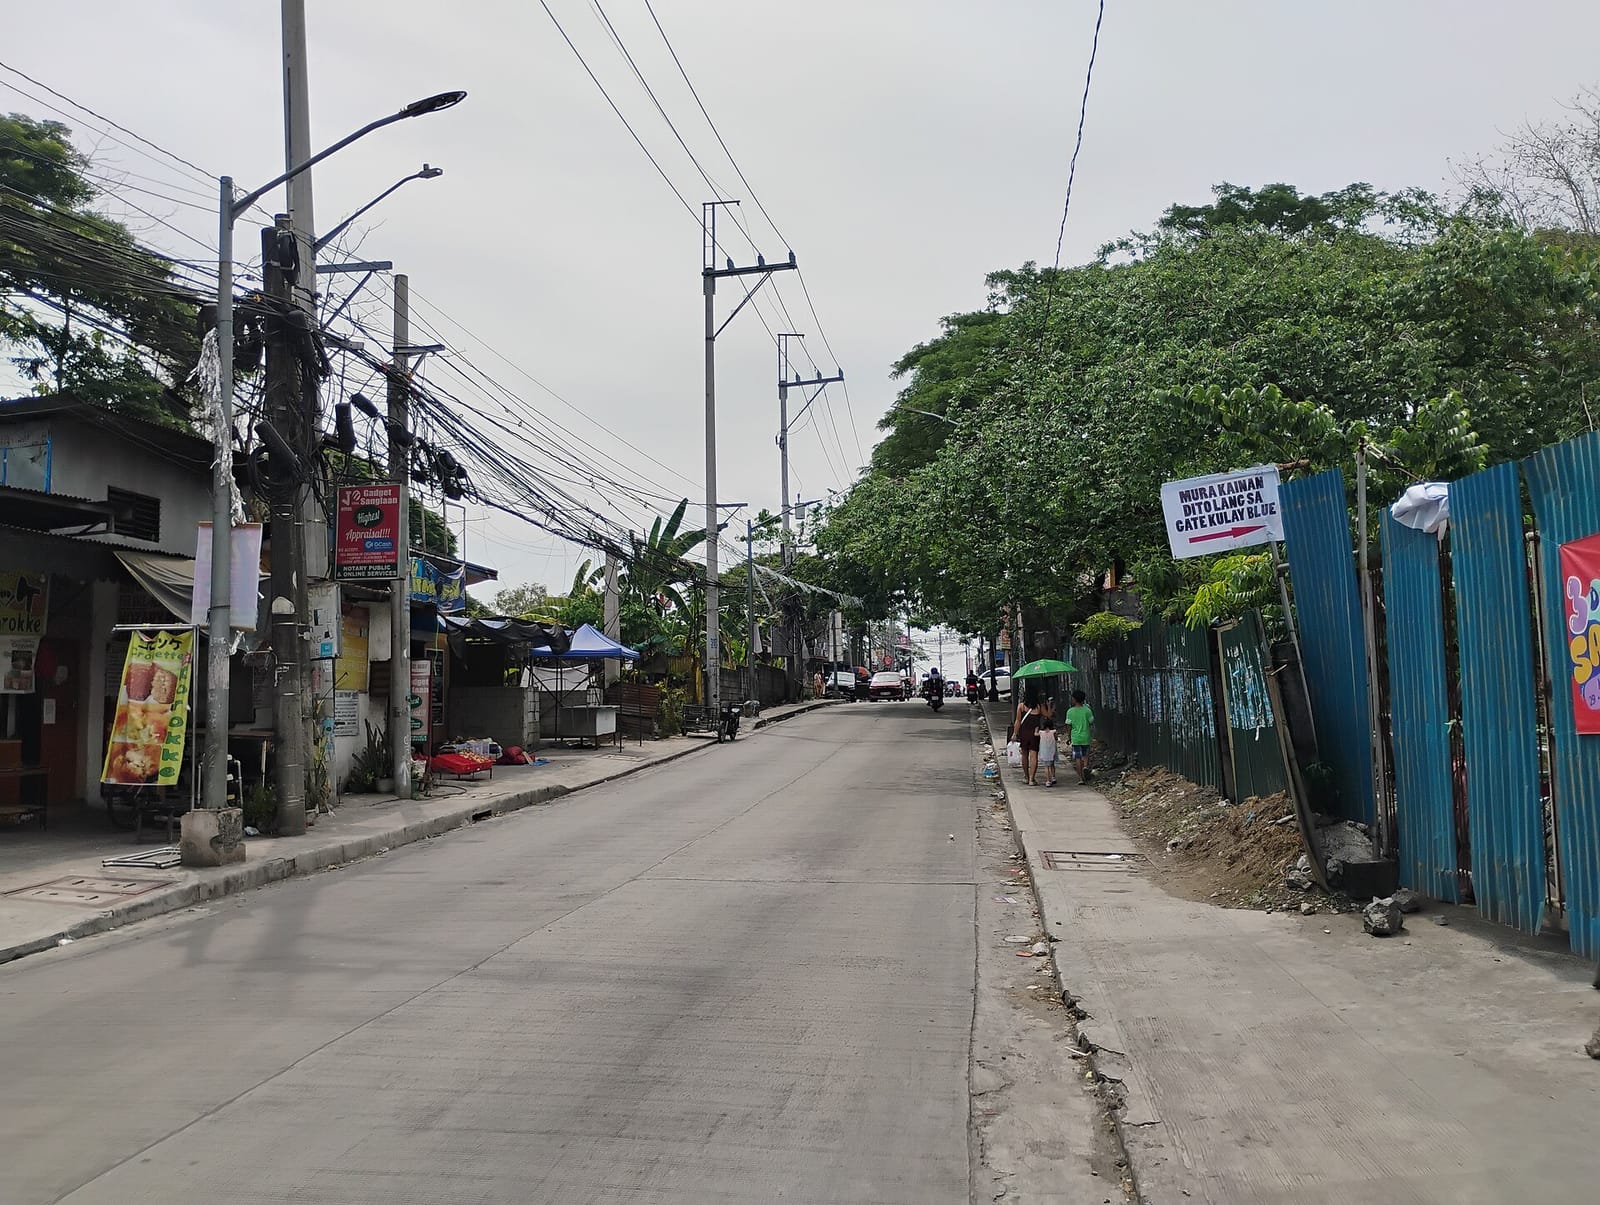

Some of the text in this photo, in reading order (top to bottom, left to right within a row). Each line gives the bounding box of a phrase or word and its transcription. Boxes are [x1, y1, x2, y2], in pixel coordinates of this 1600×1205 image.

[360, 497, 398, 505] Sanglaan
[363, 489, 391, 497] Gadget
[1179, 476, 1264, 503] MURA KAINAN
[1175, 502, 1276, 532] GATE KULAY BLUE
[1183, 491, 1263, 517] DITO LANG SA
[1567, 575, 1588, 635] 3
